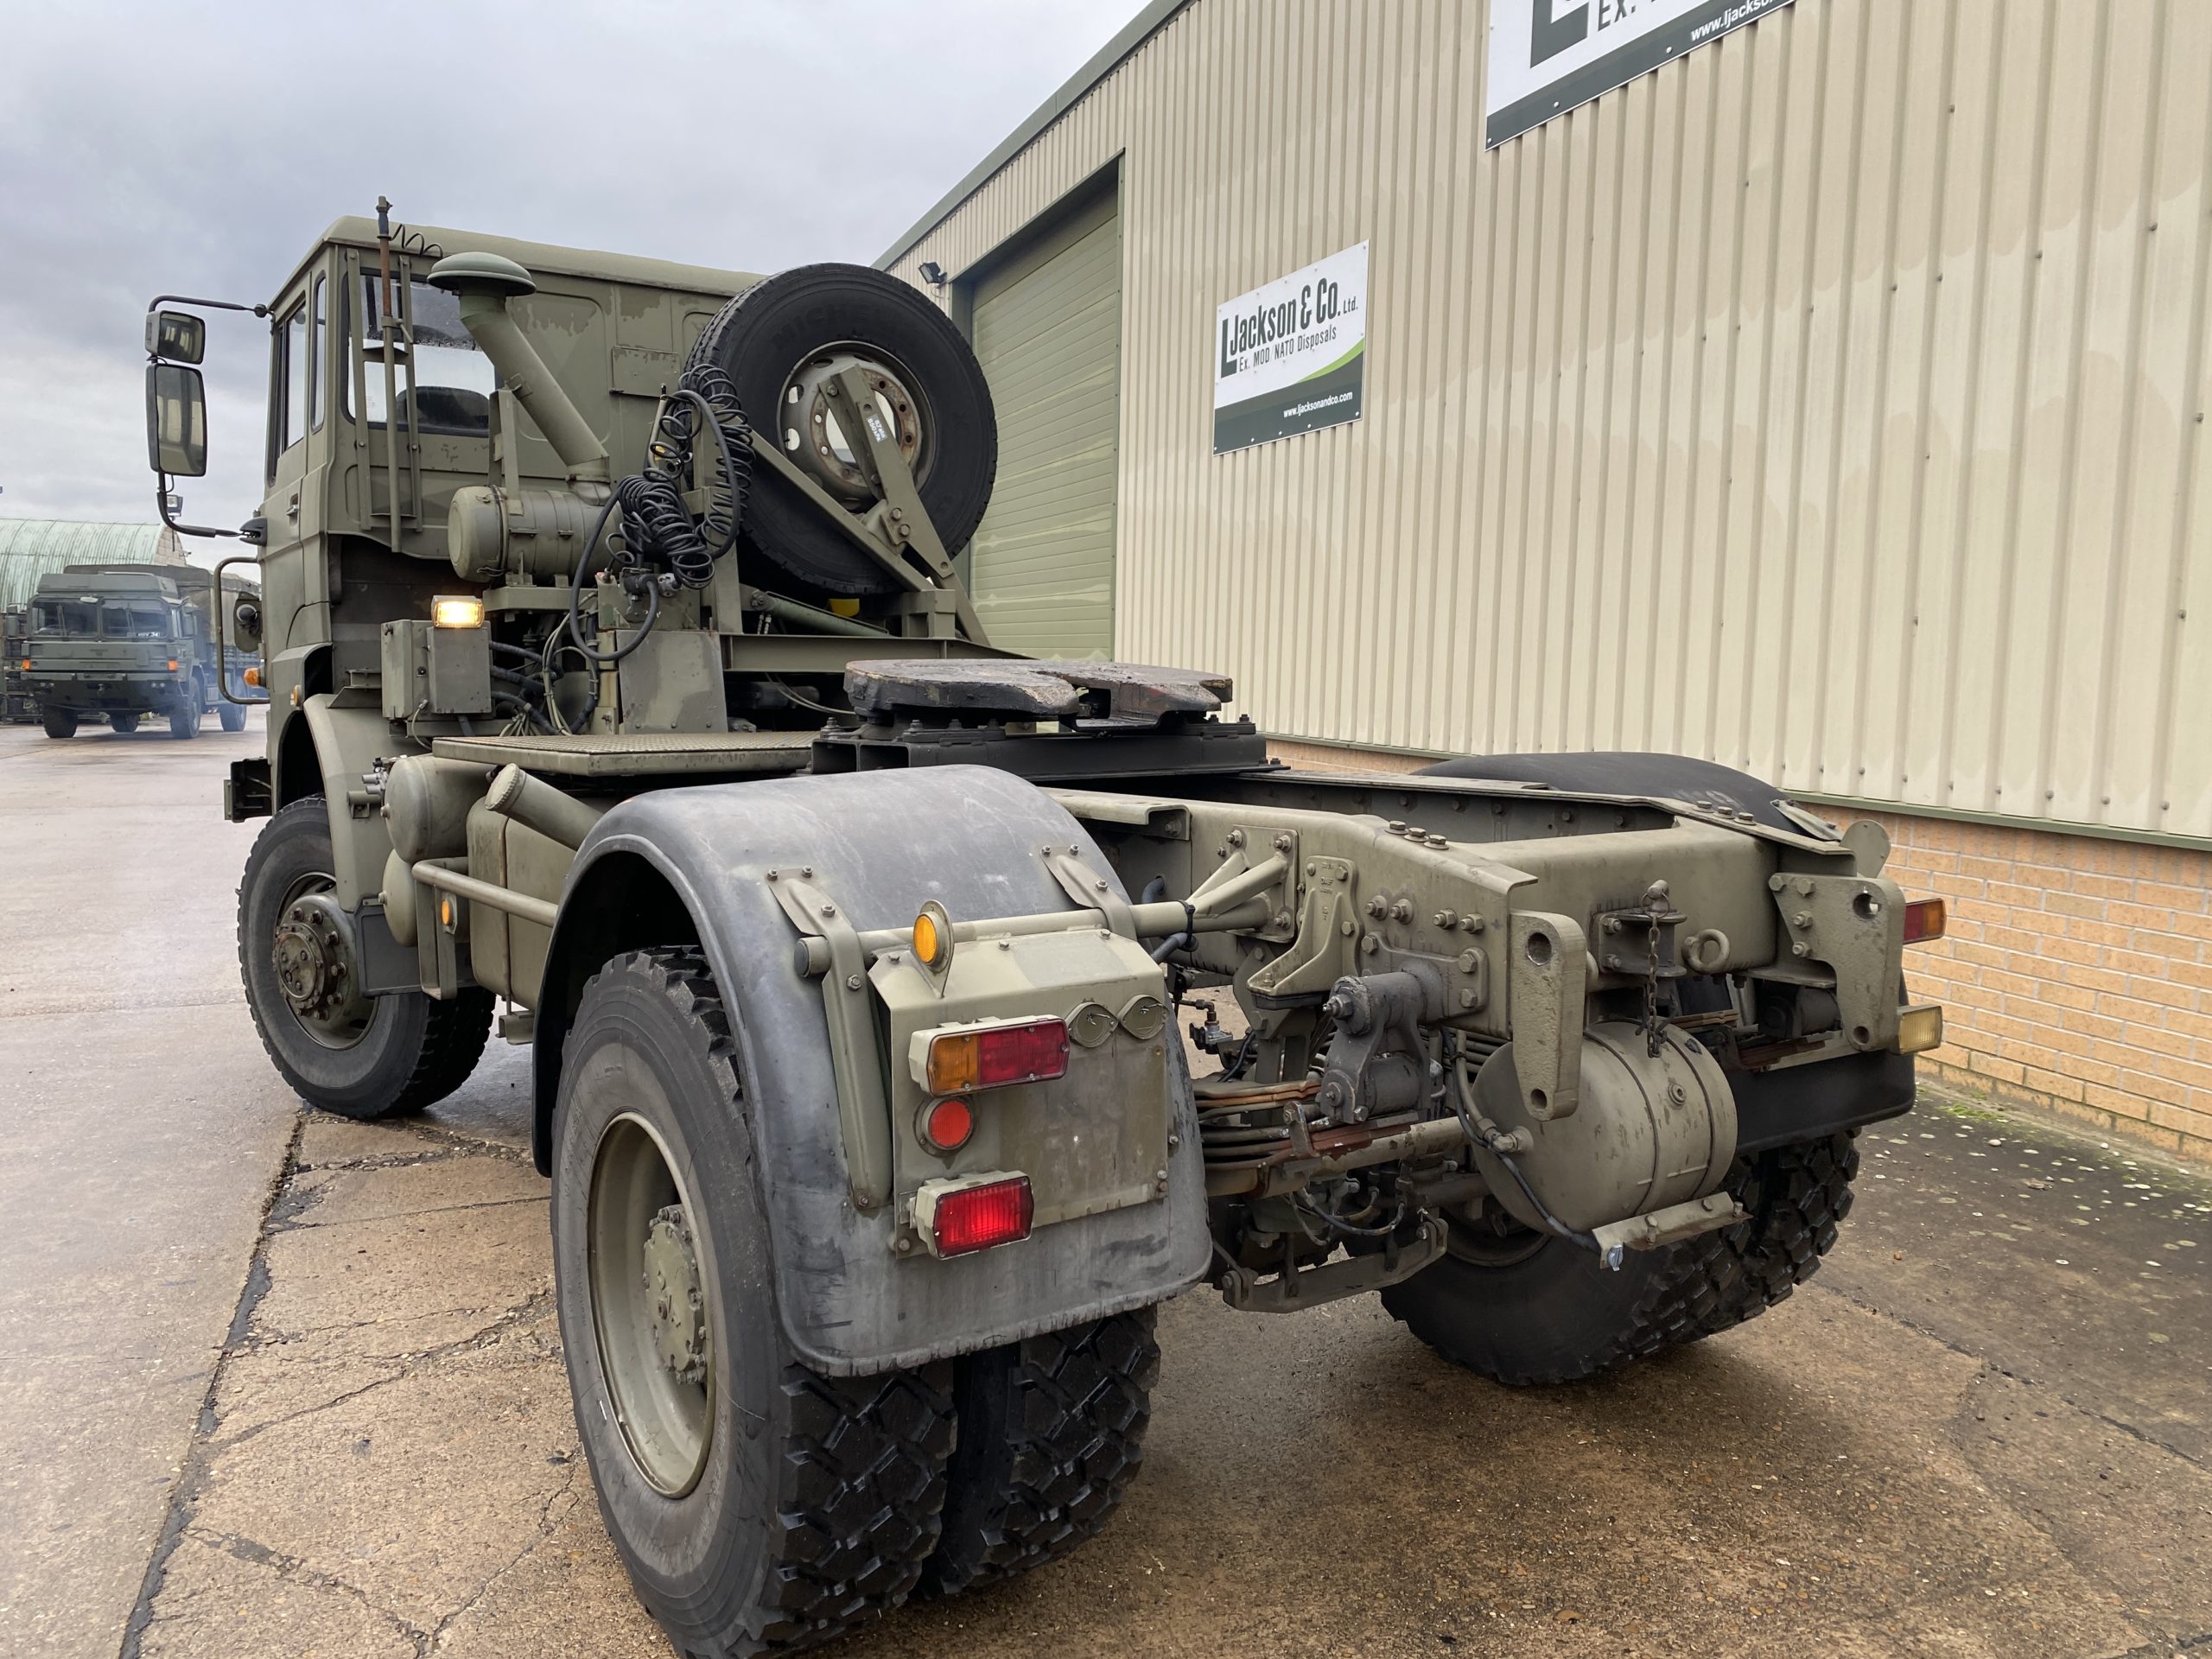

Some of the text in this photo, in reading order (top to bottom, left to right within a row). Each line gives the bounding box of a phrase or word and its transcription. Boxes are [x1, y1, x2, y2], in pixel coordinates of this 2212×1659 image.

[1300, 285, 1312, 330] &
[1316, 277, 1340, 324] Co.
[1344, 296, 1358, 315] Ltd.
[1239, 357, 1250, 372] Ex.
[1253, 347, 1269, 367] MOD
[1274, 338, 1294, 360] NATO
[1298, 324, 1337, 352] Disposals
[1283, 391, 1353, 417] www.ljacksonandco.com
